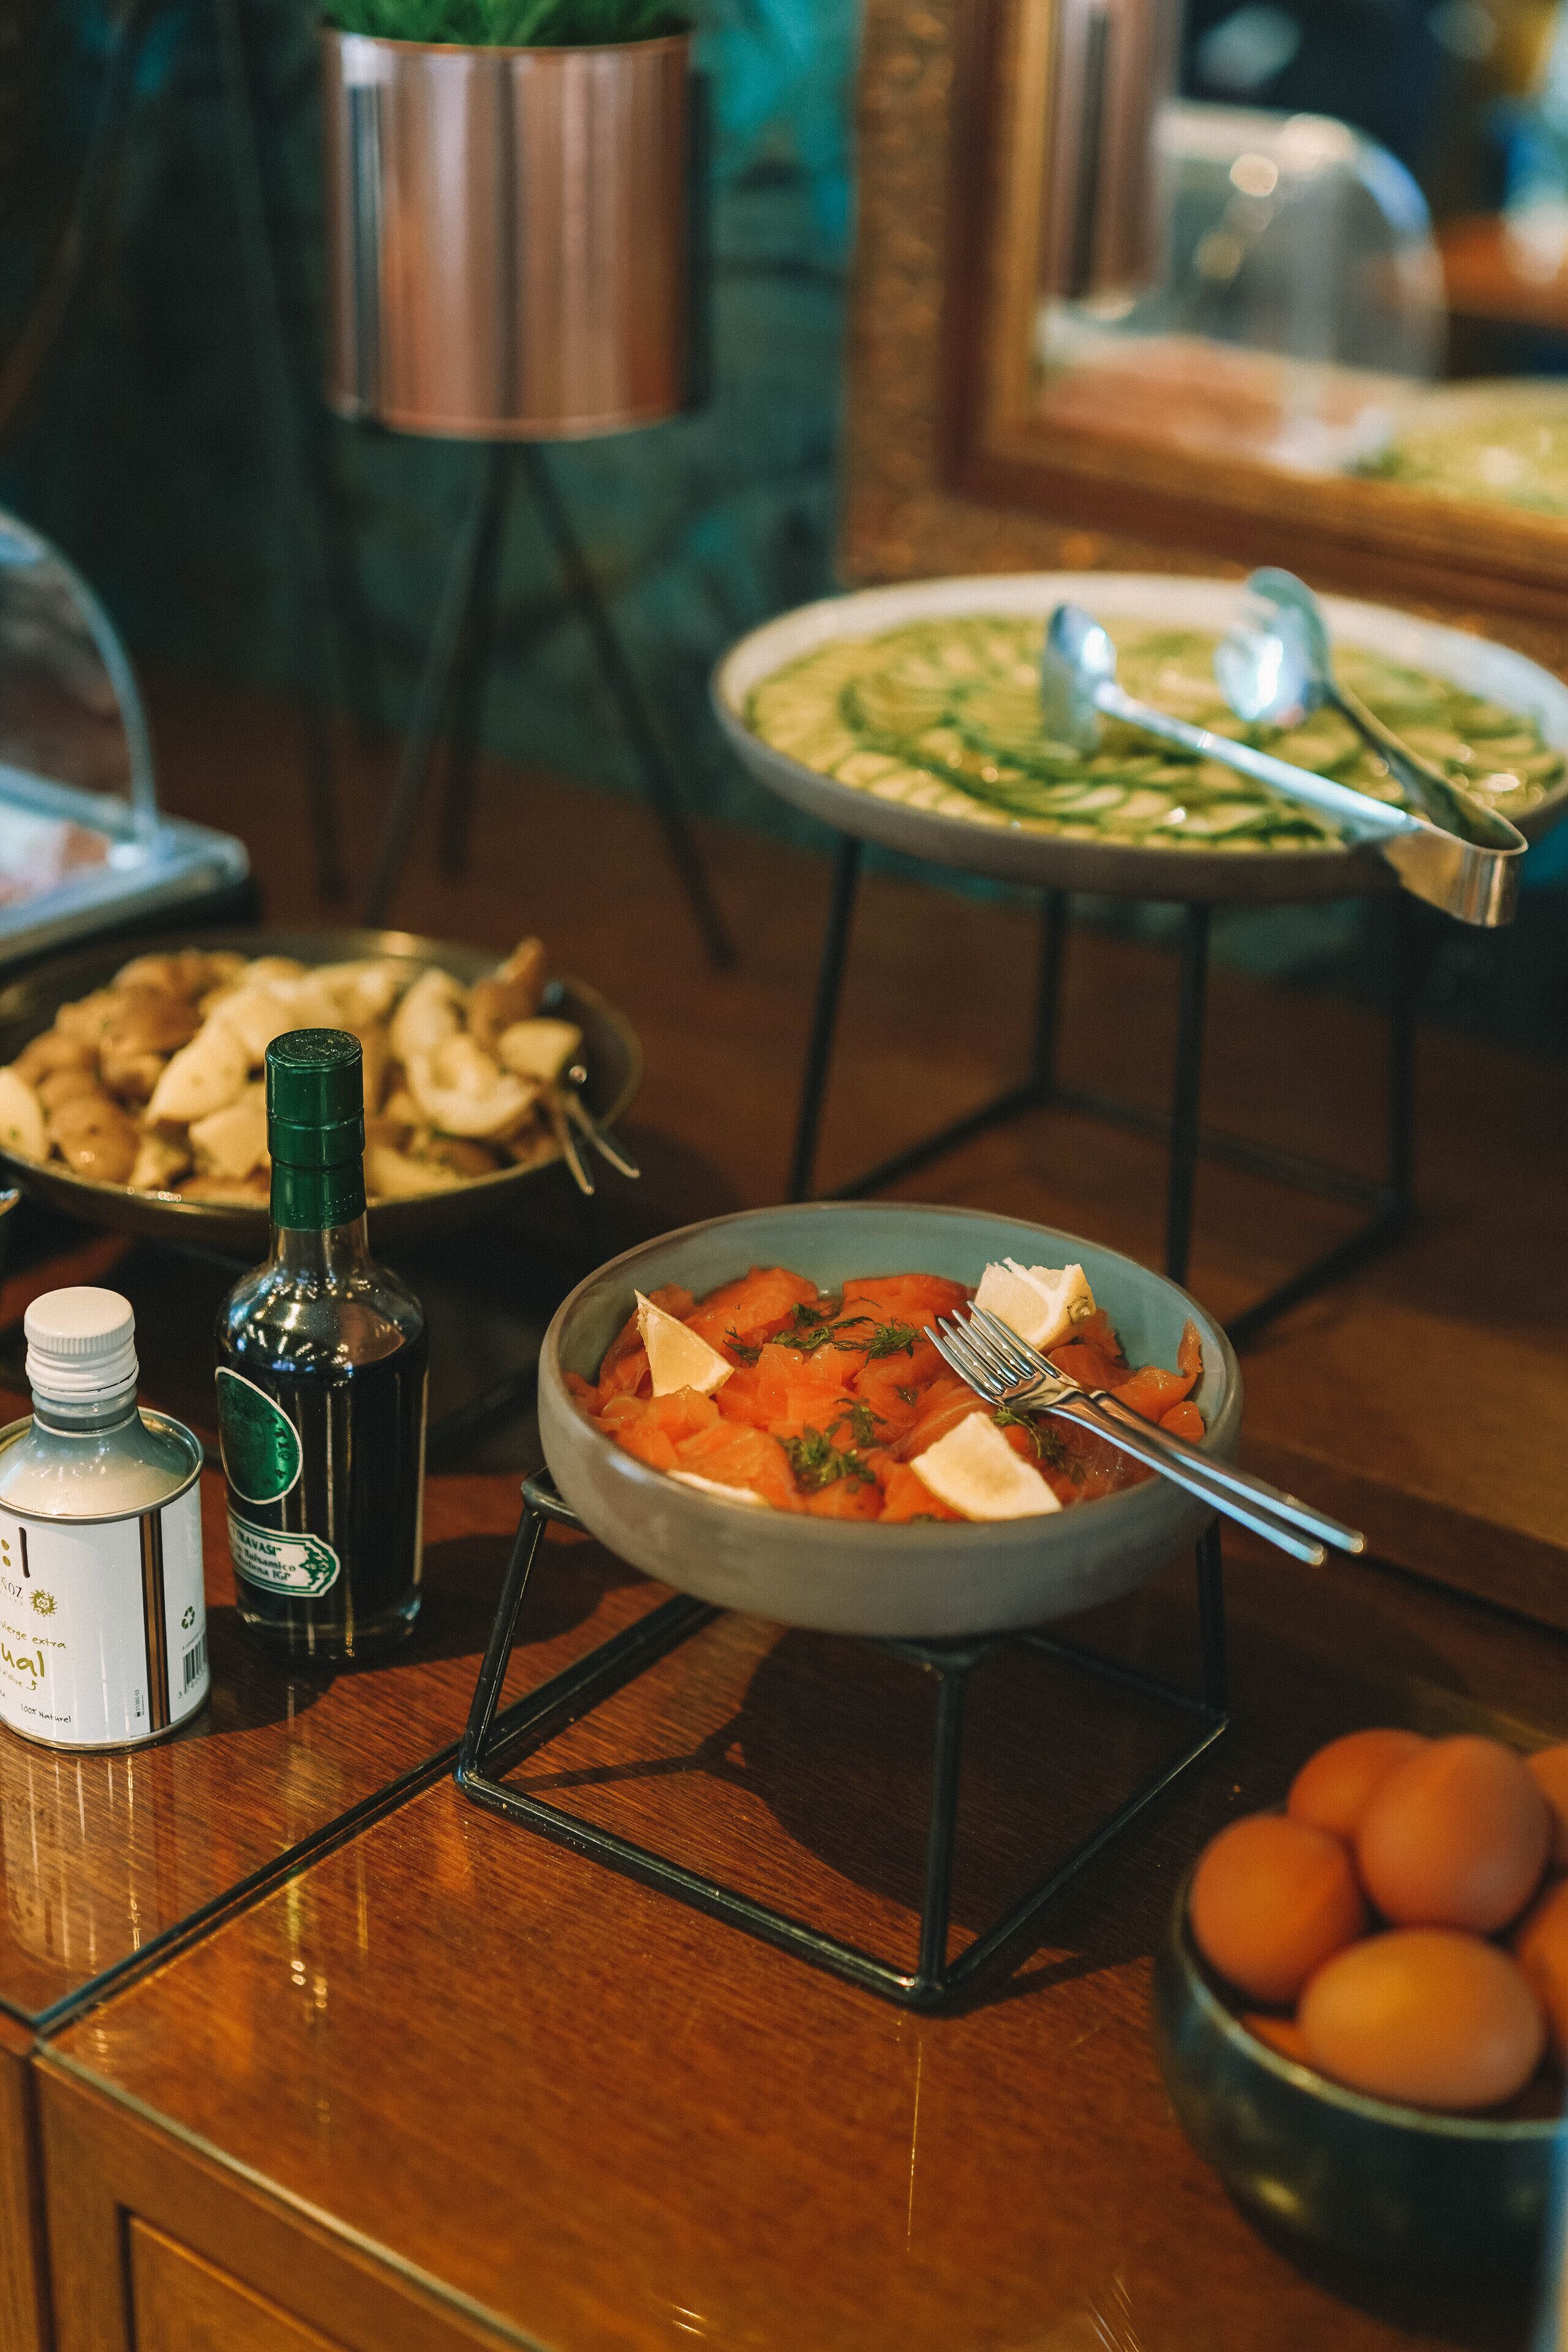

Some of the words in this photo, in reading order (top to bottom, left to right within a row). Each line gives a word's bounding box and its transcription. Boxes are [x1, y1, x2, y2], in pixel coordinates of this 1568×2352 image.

[32, 1637, 66, 1649] extra
[21, 1703, 37, 1716] 100%
[39, 1711, 72, 1723] Naturel
